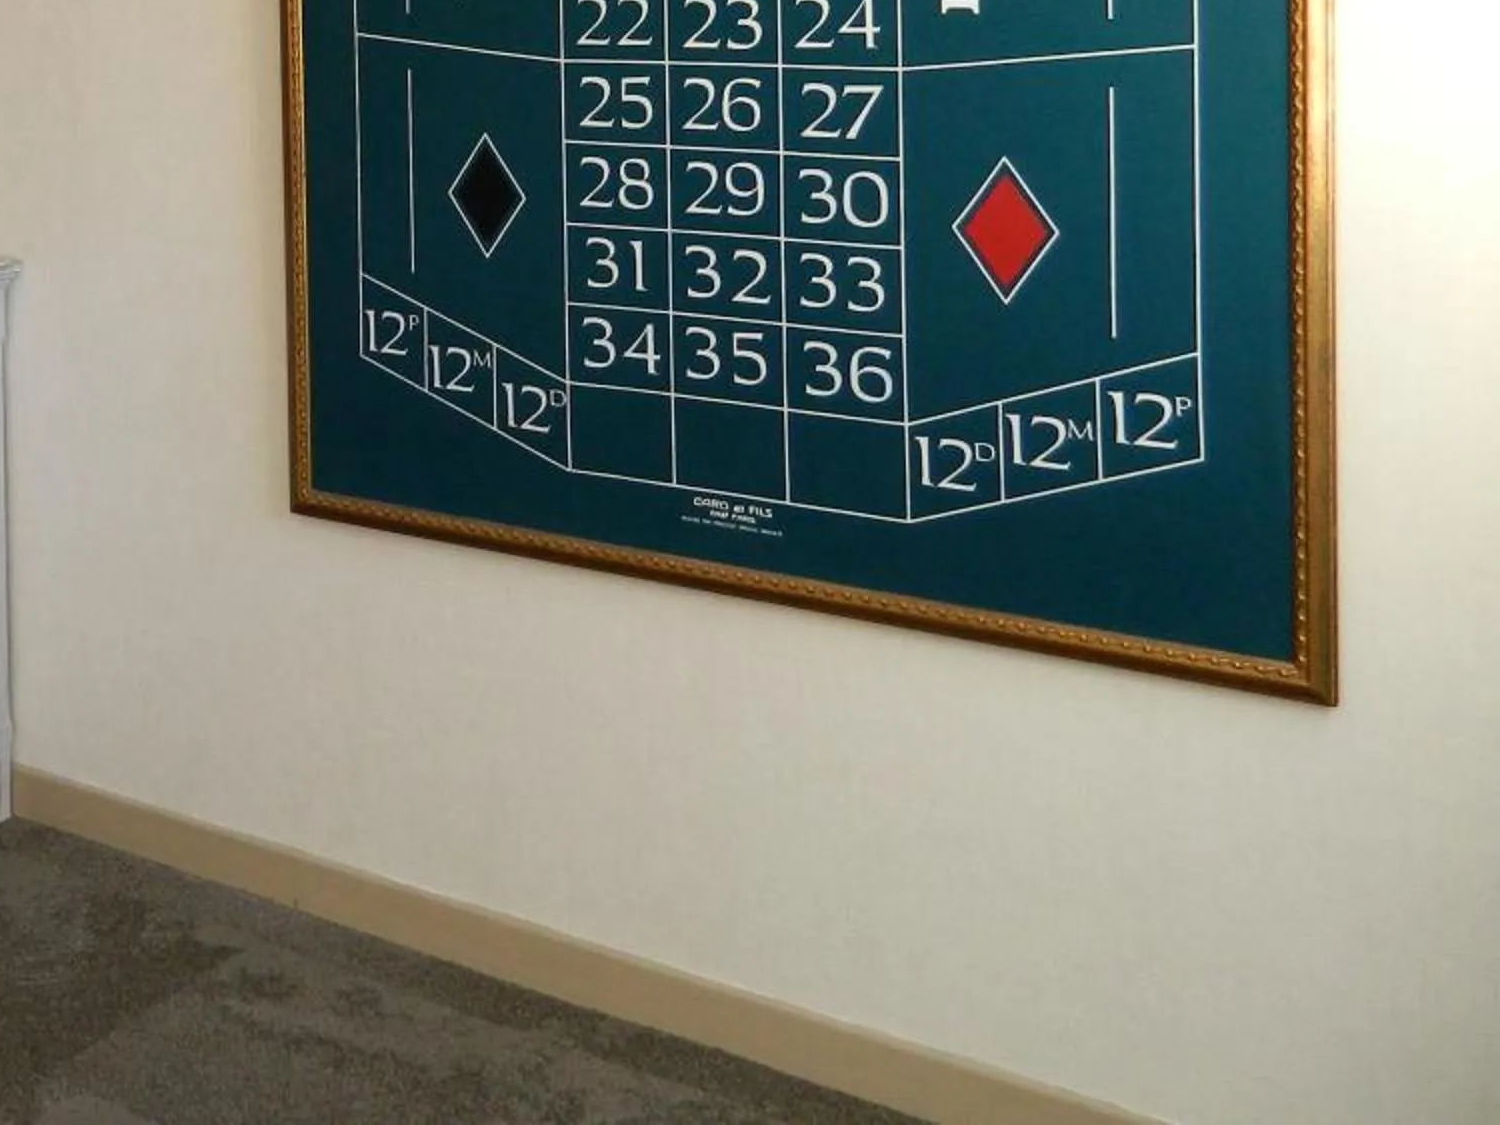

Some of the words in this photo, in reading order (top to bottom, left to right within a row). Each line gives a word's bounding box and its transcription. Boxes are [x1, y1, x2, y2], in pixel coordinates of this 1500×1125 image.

[579, 75, 654, 130] 25
[681, 77, 762, 132] 26
[800, 82, 885, 140] 27
[579, 156, 654, 210] 28
[685, 160, 765, 217] 29
[798, 168, 889, 228] 30
[585, 236, 648, 292] 31
[684, 244, 772, 305] 32
[799, 252, 886, 313] 33
[582, 316, 662, 376] 34
[685, 326, 768, 386] 35
[803, 340, 893, 404] 36
